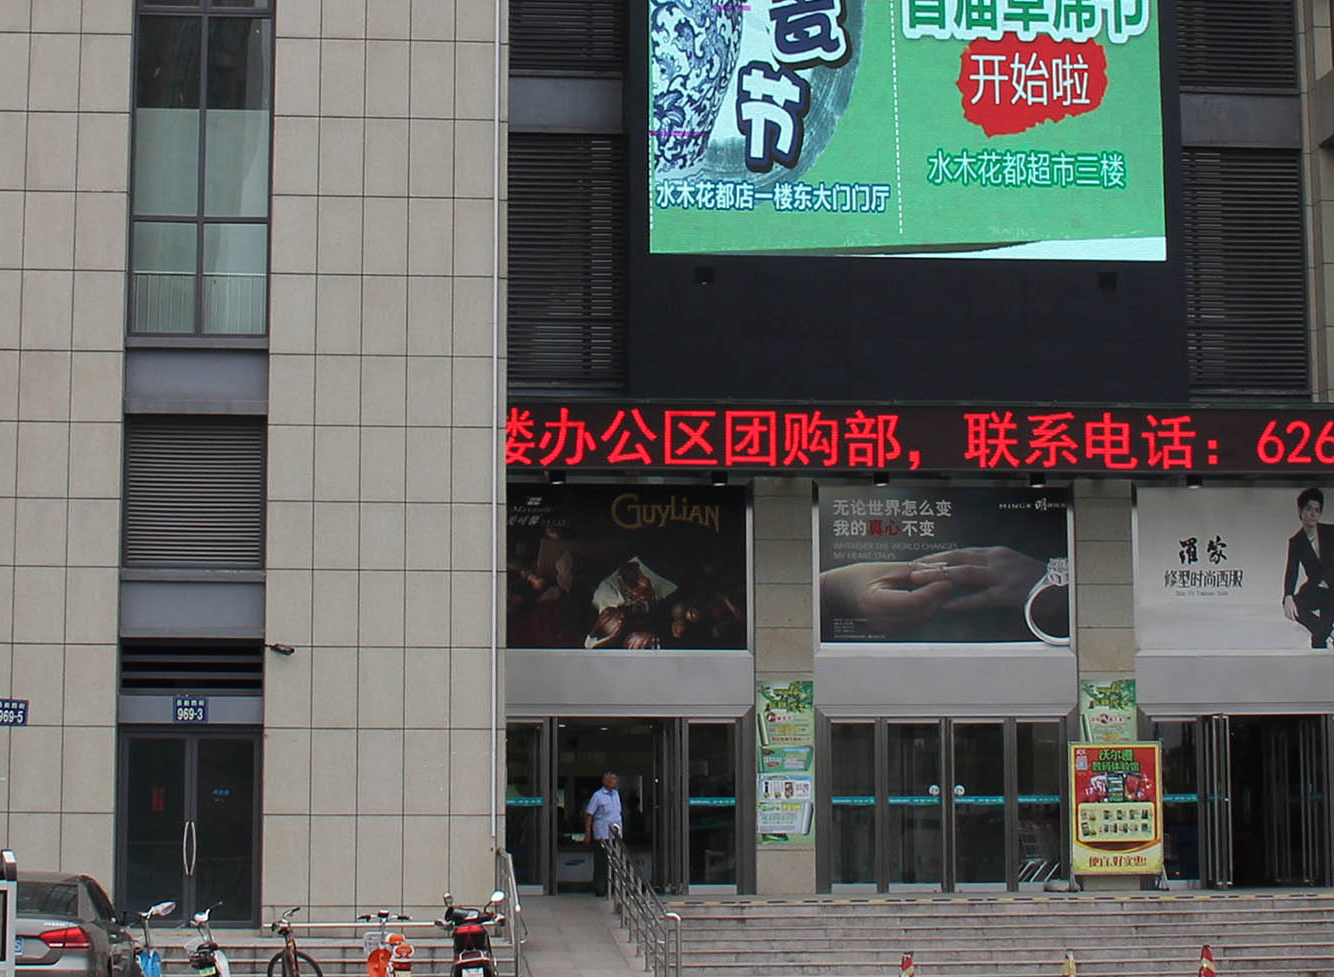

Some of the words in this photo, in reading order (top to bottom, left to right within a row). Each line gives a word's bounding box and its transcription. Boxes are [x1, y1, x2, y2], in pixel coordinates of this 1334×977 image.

[969, 53, 1091, 107] 开始啦
[927, 149, 1126, 189] 水木花都超市三楼
[655, 181, 891, 214] 水木花都店一楼东大门门厅
[833, 498, 953, 517] 无论世界怎么变
[833, 519, 936, 537] 我的真心不变
[177, 707, 204, 721] 969-3
